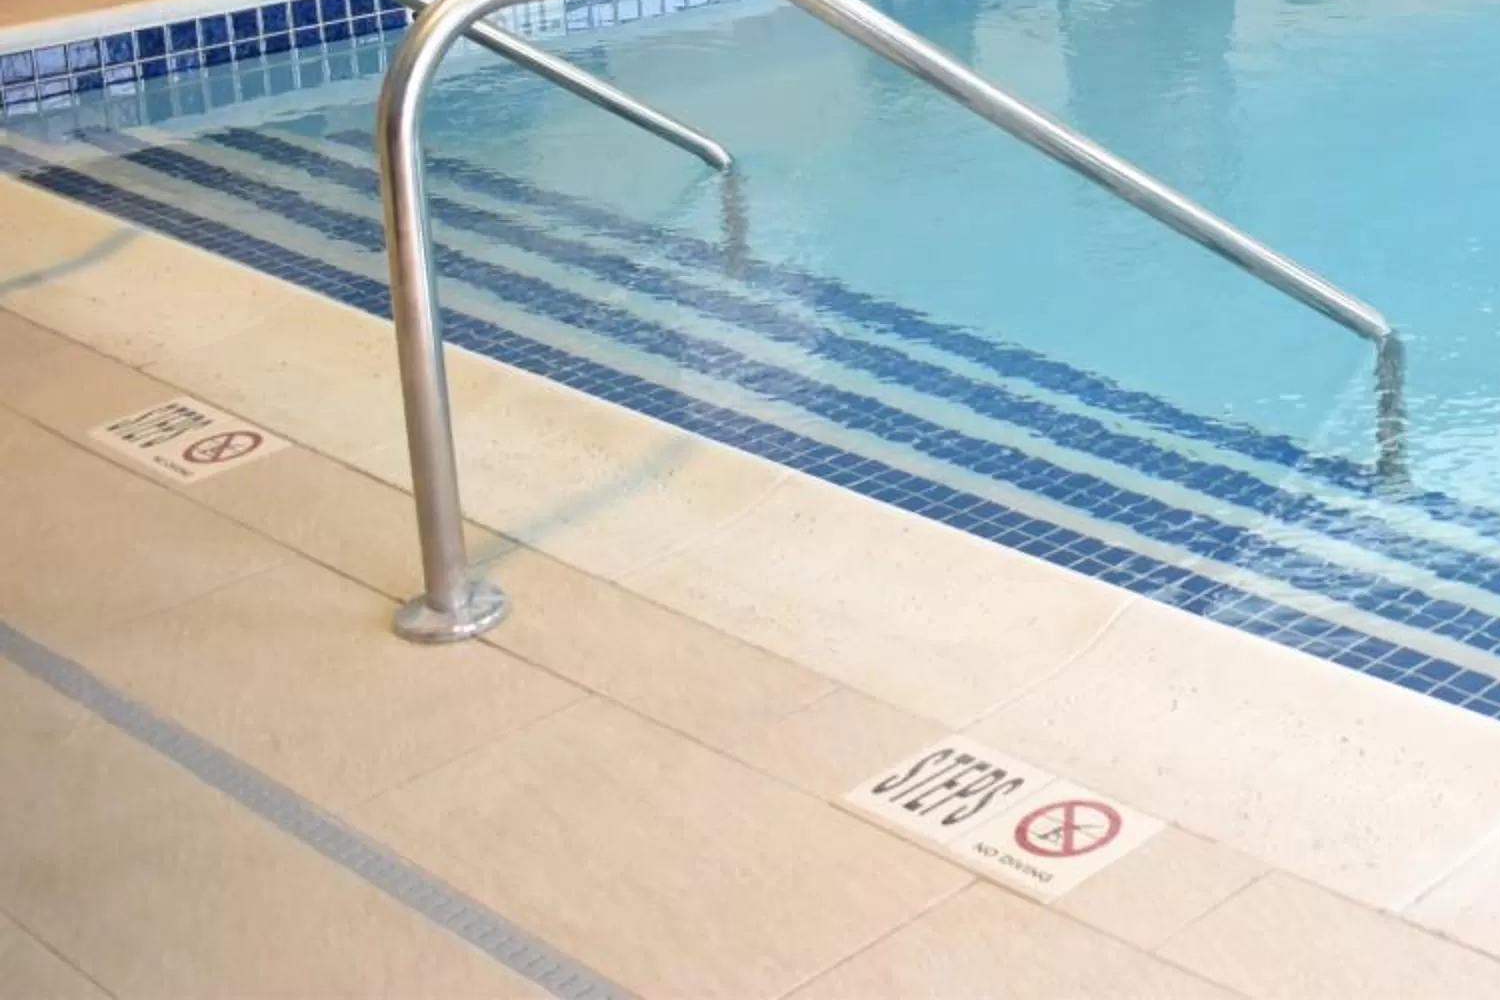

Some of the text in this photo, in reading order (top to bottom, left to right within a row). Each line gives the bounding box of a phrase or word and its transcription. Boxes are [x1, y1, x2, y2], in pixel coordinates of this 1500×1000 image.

[871, 748, 1025, 826] STEPS
[972, 842, 1054, 882] NO DIVING
